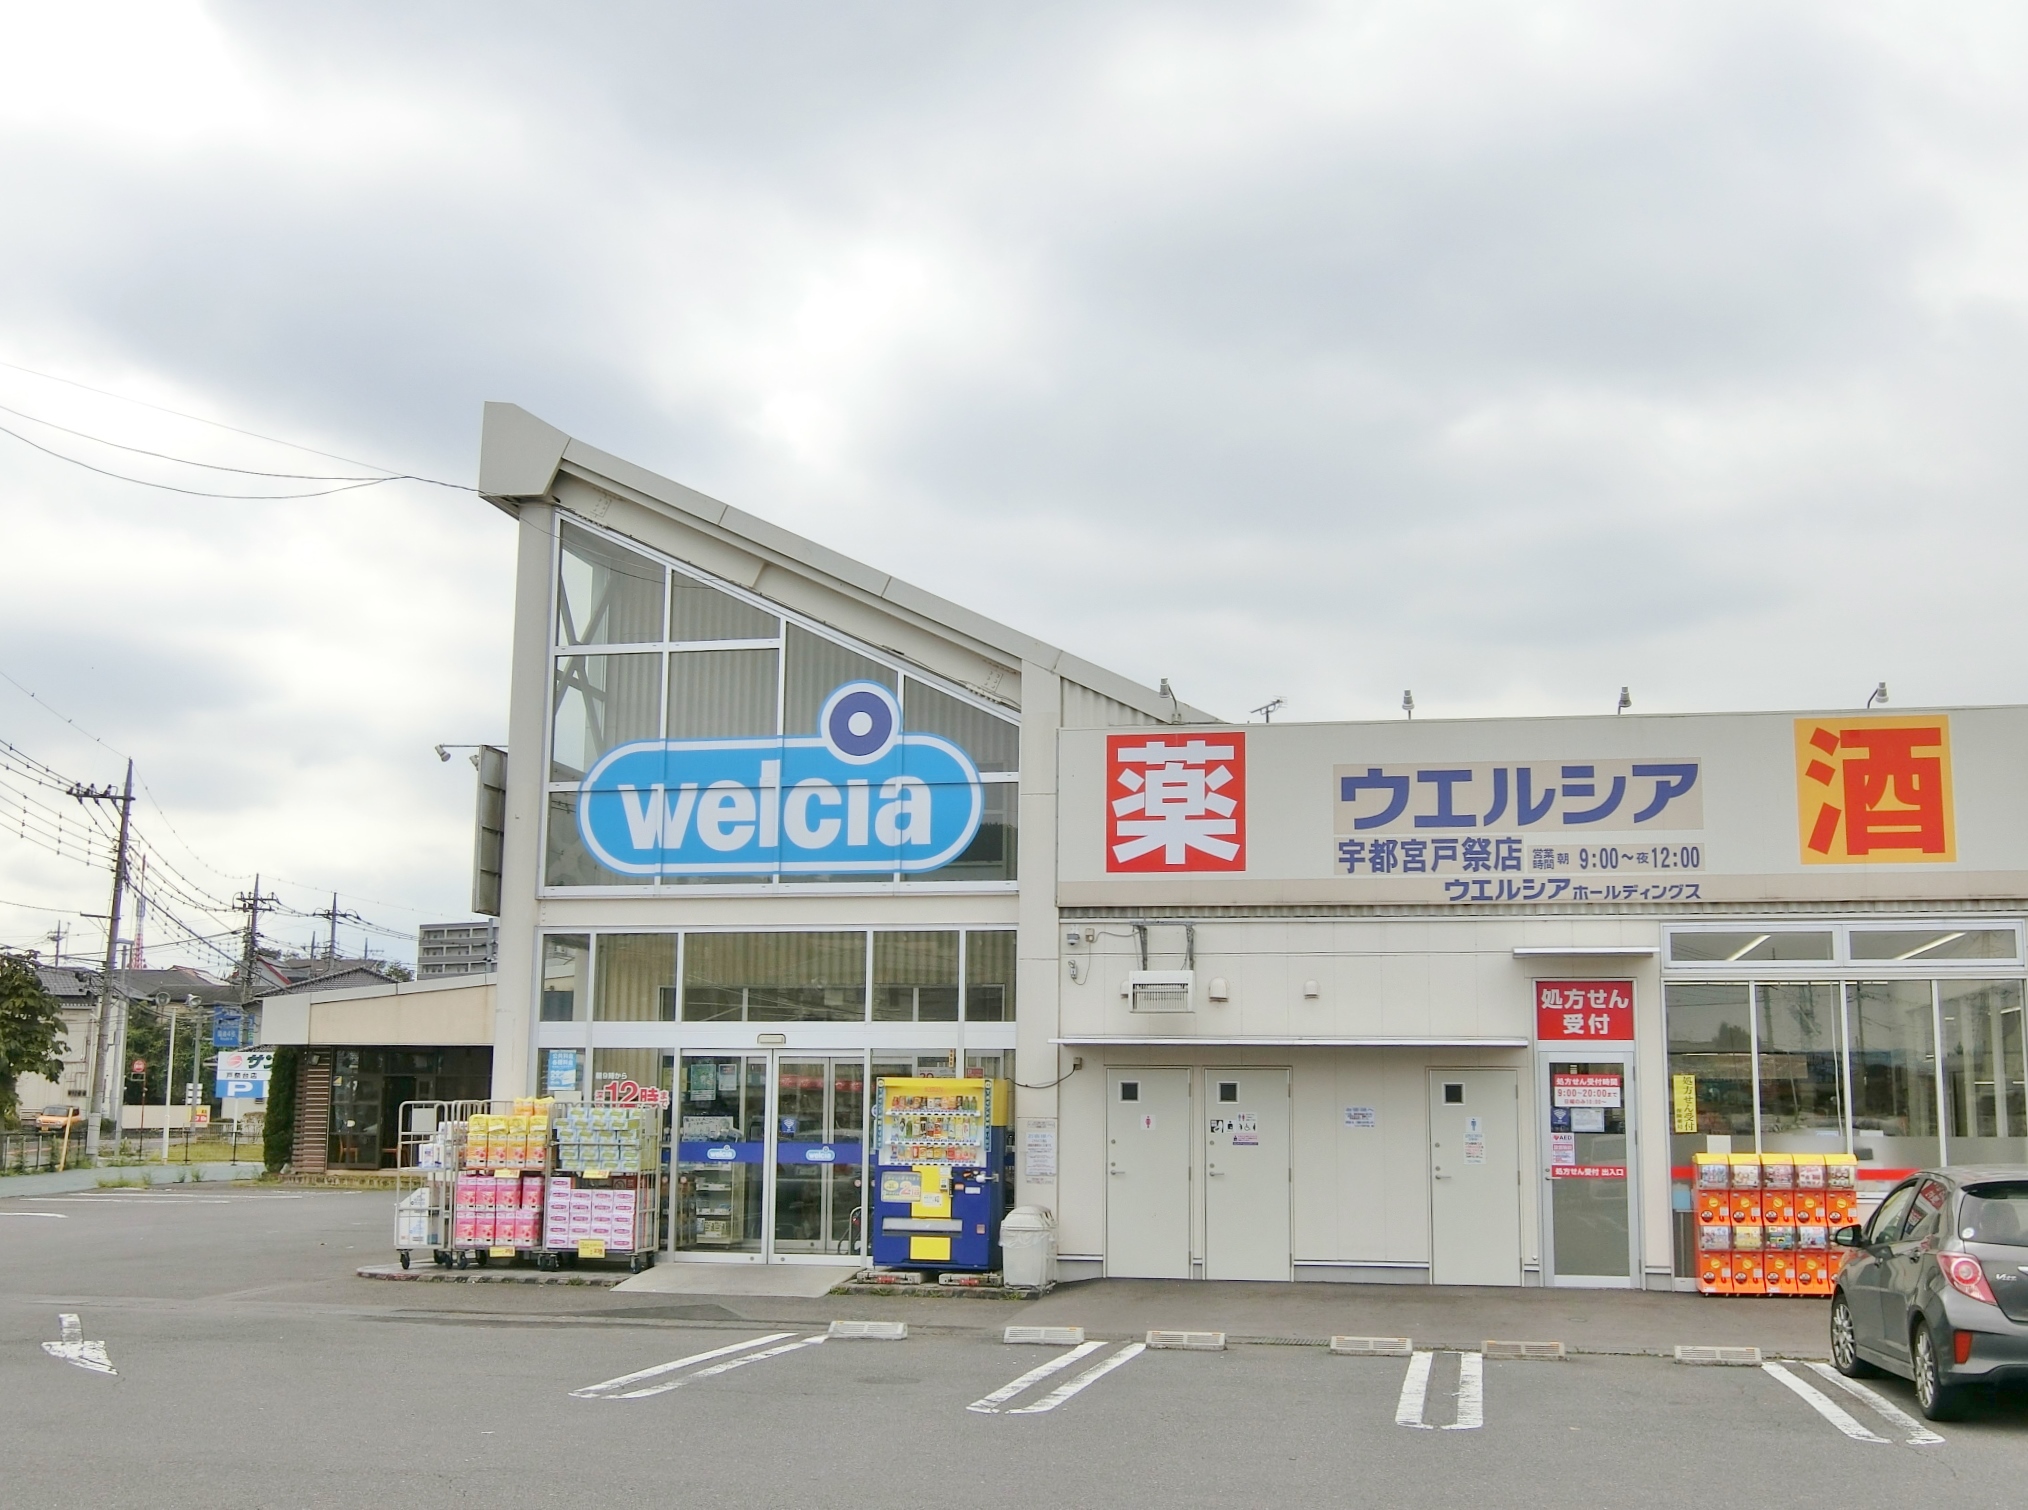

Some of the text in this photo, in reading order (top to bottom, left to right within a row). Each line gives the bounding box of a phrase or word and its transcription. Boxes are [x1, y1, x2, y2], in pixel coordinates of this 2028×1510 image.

[618, 759, 932, 852] welcia
[1111, 740, 1241, 865] 薬
[1341, 763, 1699, 830] ウエルシア
[1805, 727, 1946, 856] 酒
[1338, 836, 1523, 874] 宇都宮戸祭店
[1541, 988, 1630, 1010] 処方せん
[1562, 1013, 1611, 1035] 受付
[227, 1081, 253, 1096] P
[1556, 1077, 1619, 1086] 処方せん受付時間
[1683, 1076, 1695, 1131] 処方せん受付
[1555, 1167, 1624, 1176] 処方せん受付 出入口
